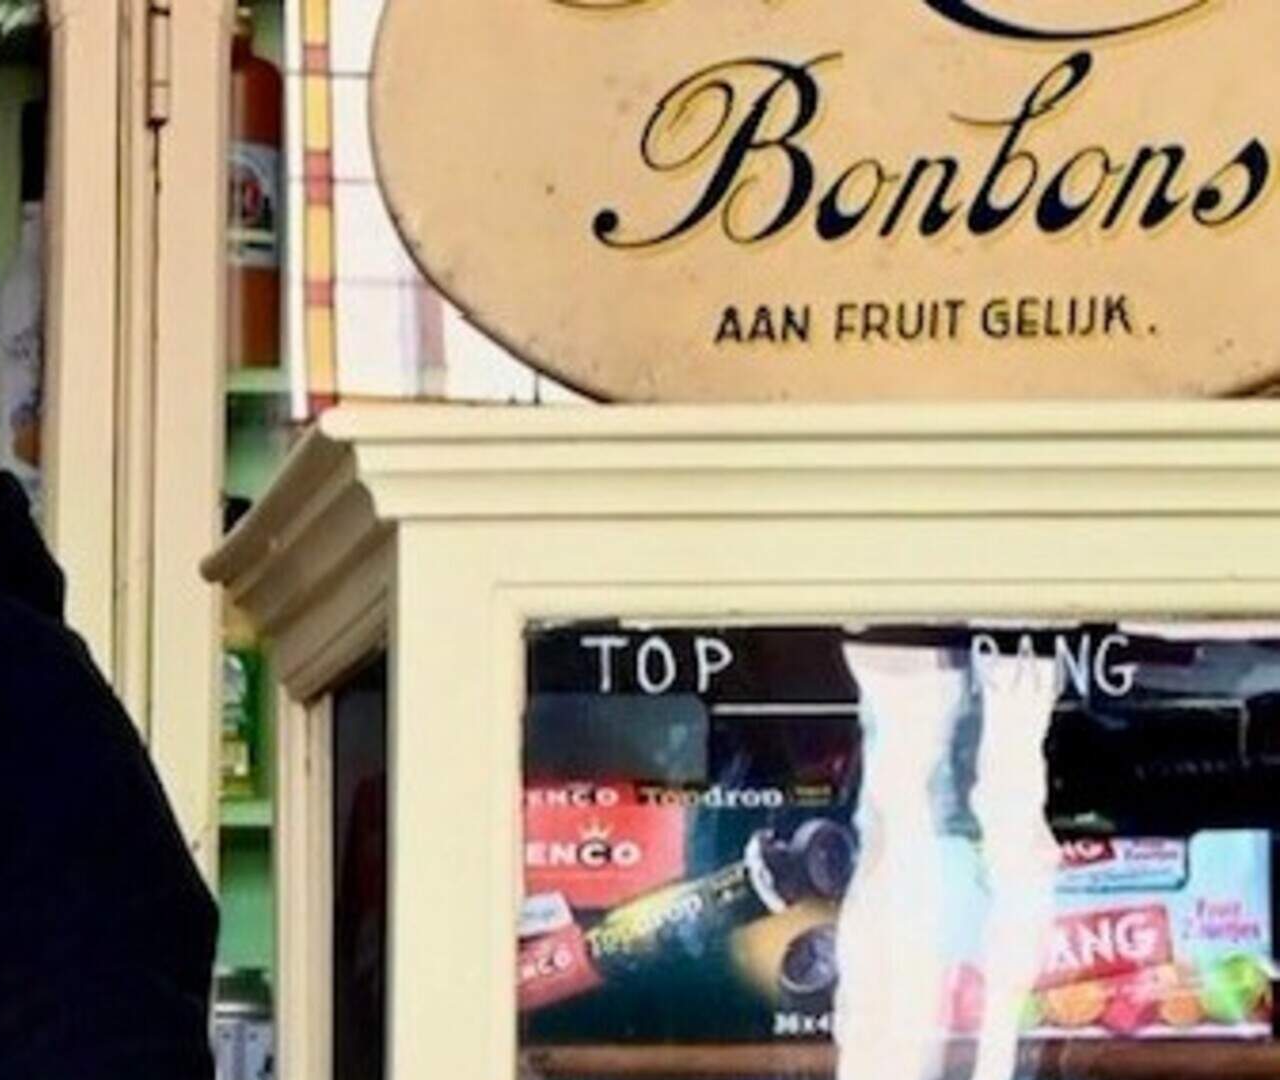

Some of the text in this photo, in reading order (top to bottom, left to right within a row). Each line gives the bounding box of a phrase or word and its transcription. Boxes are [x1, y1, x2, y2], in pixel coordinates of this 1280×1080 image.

[592, 50, 1269, 248] Bonbons
[713, 304, 811, 344] AAN
[833, 299, 967, 341] FRUIT
[580, 635, 733, 694] TOP
[527, 785, 620, 808] ENCO
[526, 840, 642, 867] ENCO
[1048, 908, 1160, 970] ANG
